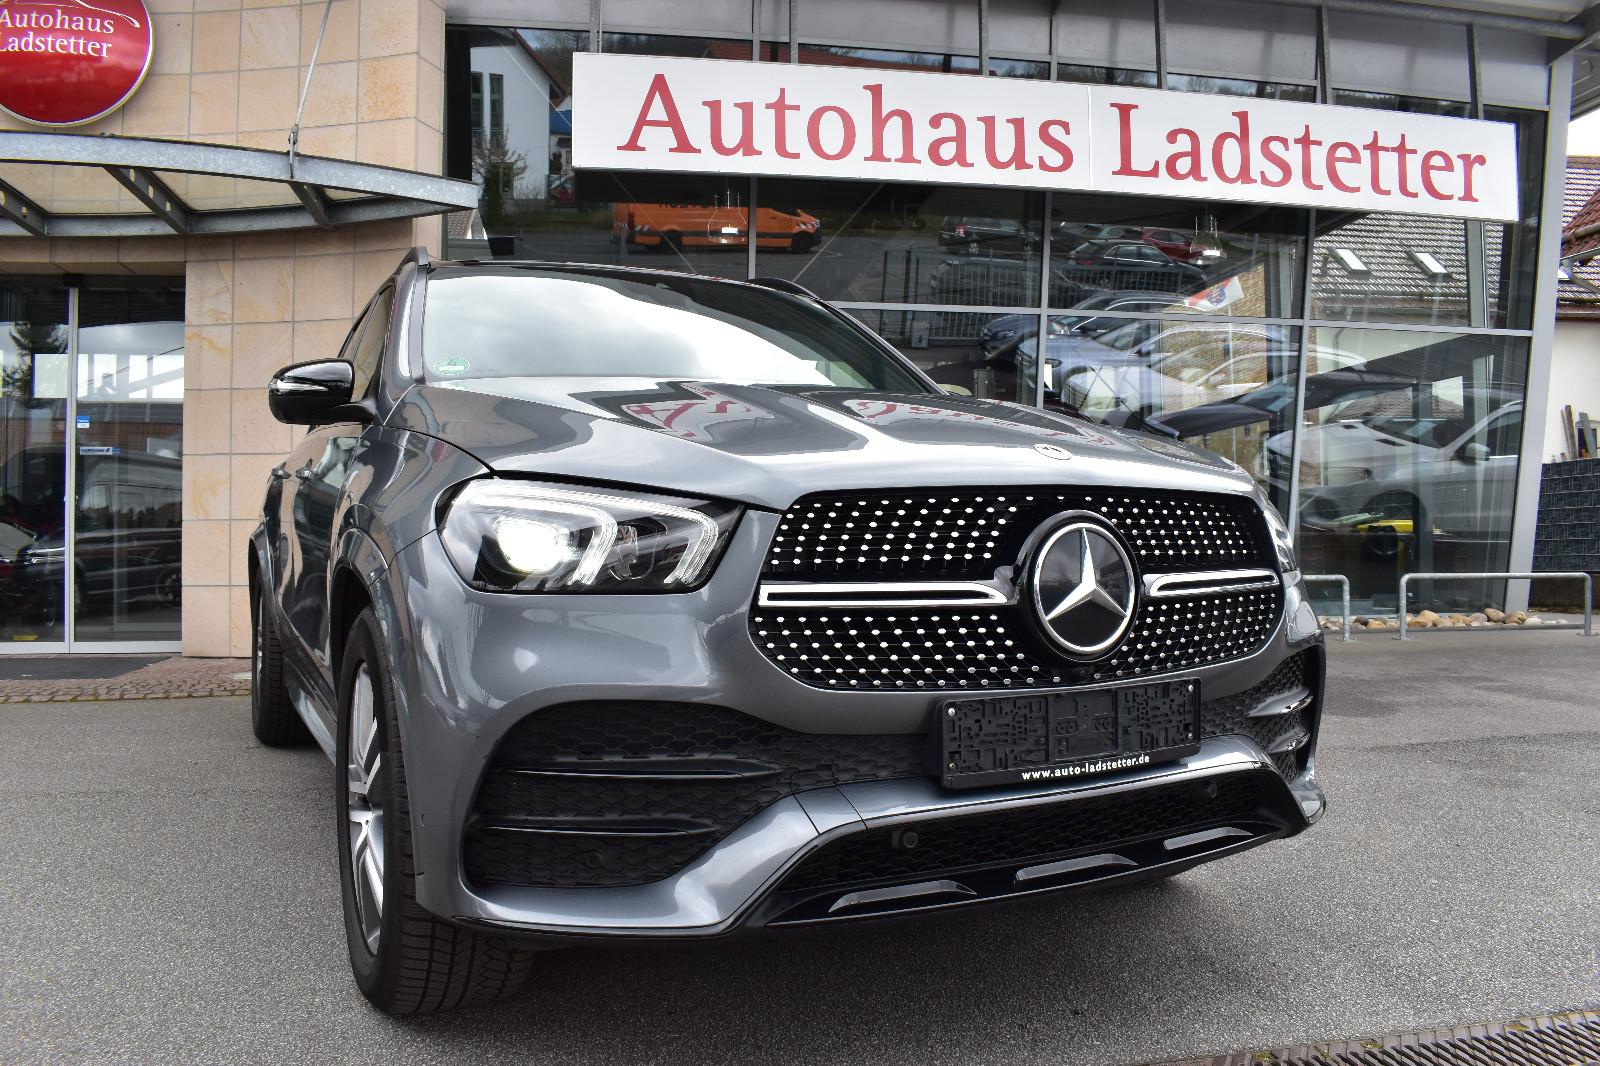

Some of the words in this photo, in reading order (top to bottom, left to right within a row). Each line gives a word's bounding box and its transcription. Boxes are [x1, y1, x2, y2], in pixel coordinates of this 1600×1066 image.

[0, 8, 115, 34] Autohaus
[617, 74, 1074, 173] Autohaus
[1109, 103, 1487, 203] Ladstetter
[1021, 753, 1150, 780] www.auto-ladstetter.de
